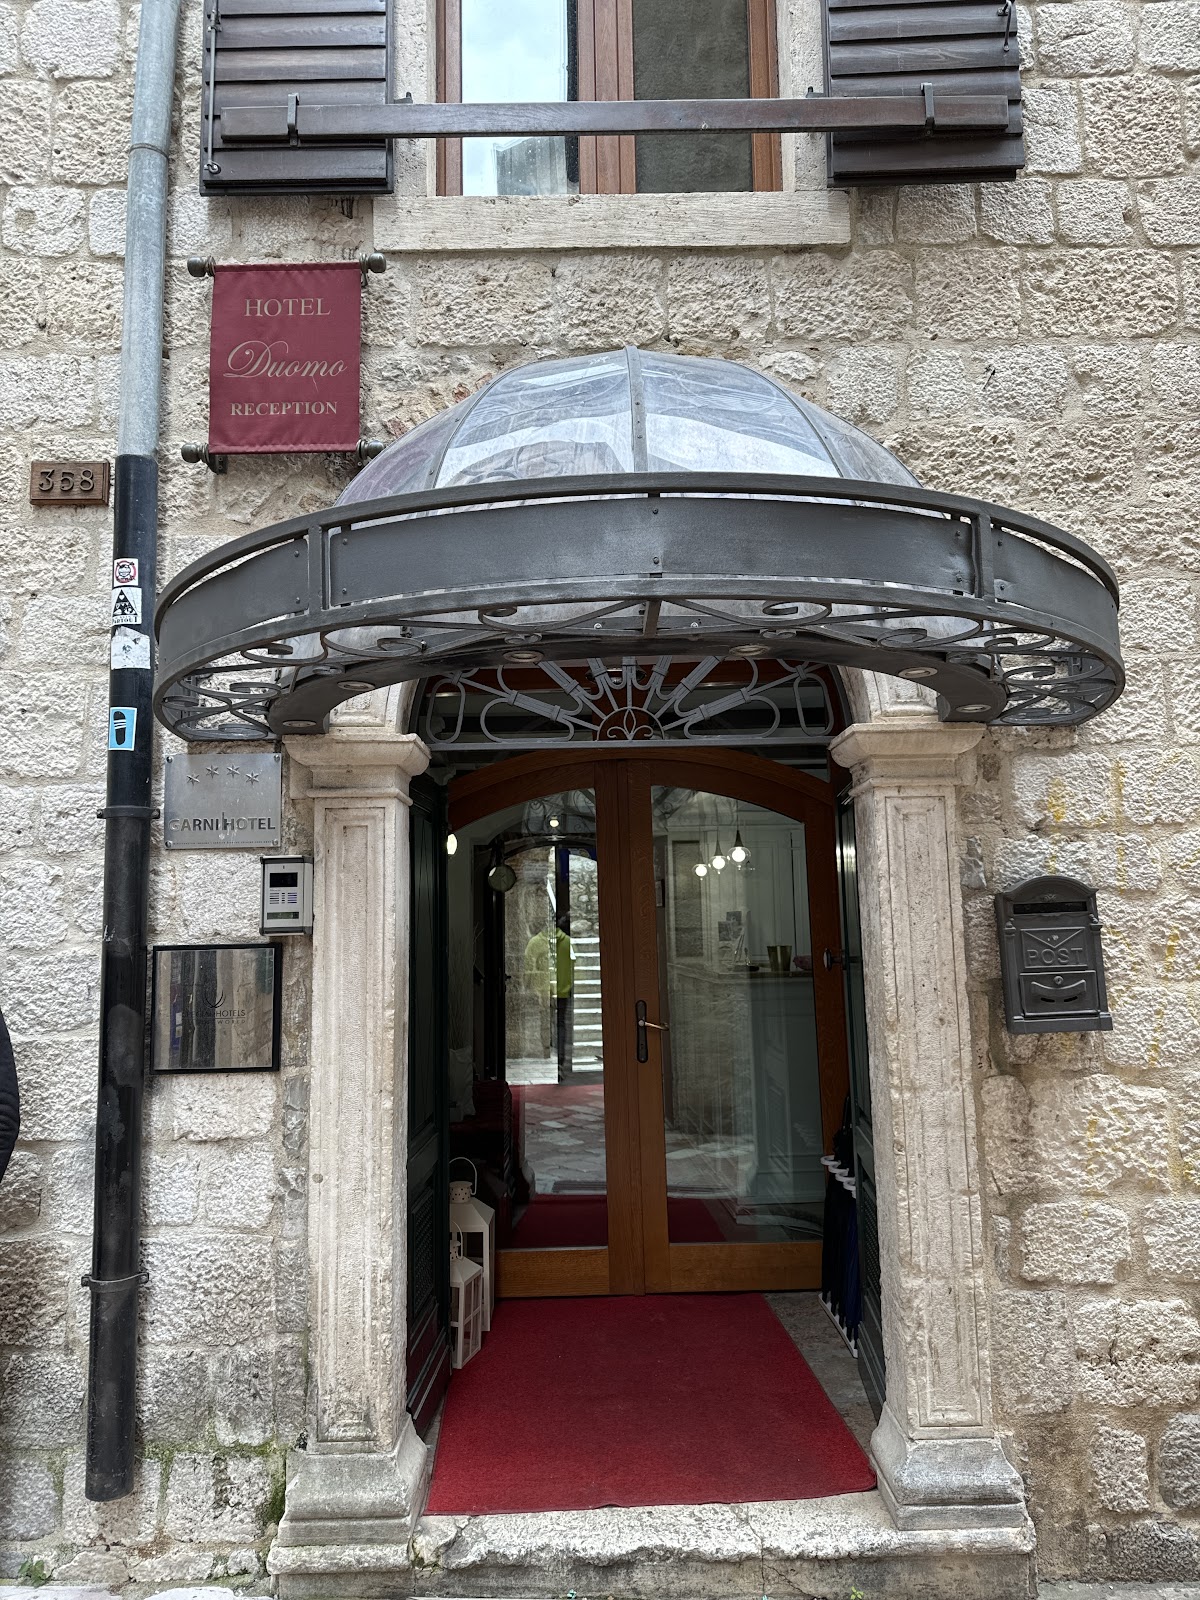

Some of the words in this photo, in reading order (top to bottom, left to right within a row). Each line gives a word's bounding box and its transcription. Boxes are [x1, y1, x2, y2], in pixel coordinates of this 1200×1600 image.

[244, 298, 331, 317] HOTEL
[223, 340, 347, 378] Duomo
[230, 402, 337, 416] RECEPTION
[38, 468, 95, 492] 358
[168, 818, 219, 832] GARNI
[221, 812, 276, 831] HOTEL
[1026, 948, 1083, 965] POST
[216, 1009, 246, 1018] HOTELS
